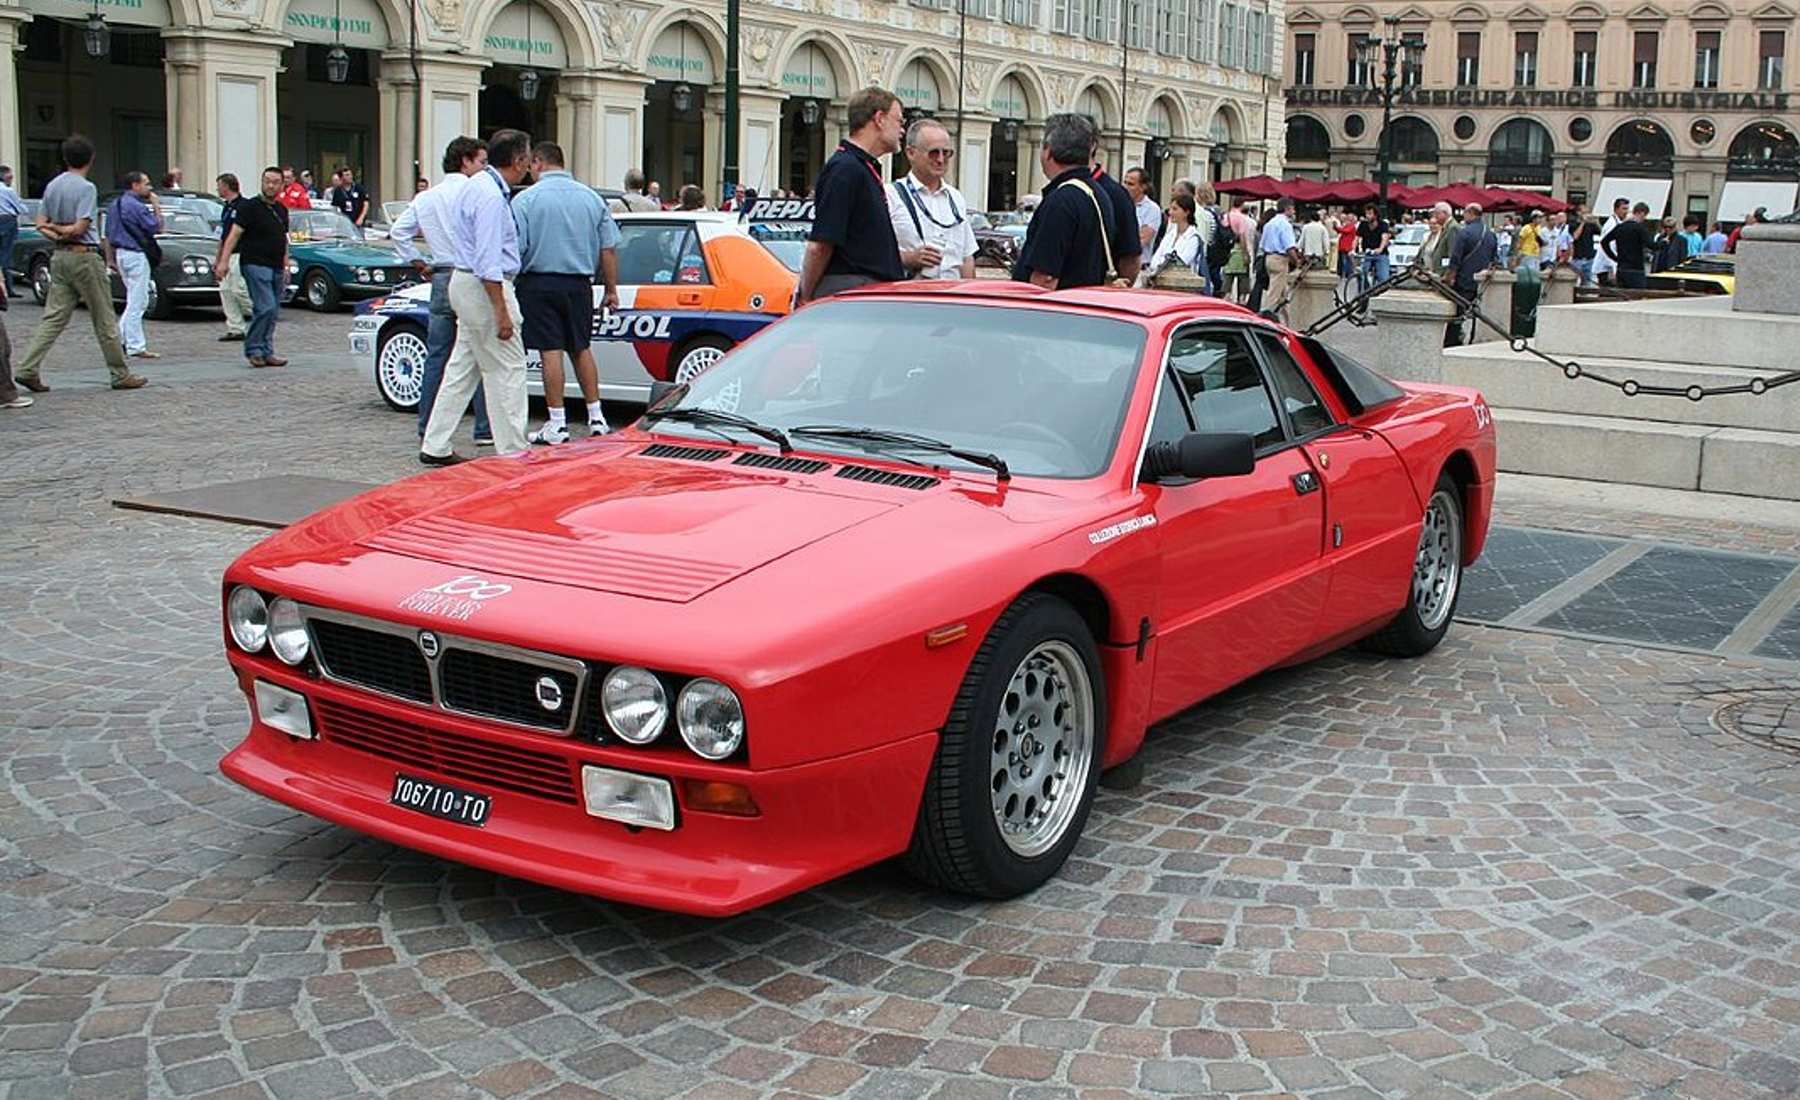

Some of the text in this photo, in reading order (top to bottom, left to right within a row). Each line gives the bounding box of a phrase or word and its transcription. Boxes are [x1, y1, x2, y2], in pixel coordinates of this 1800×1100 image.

[1399, 90, 1597, 107] ASSICURATRICE
[1615, 92, 1790, 109] INDUSTRIALE
[592, 314, 672, 338] EPSOL
[424, 575, 513, 600] 100
